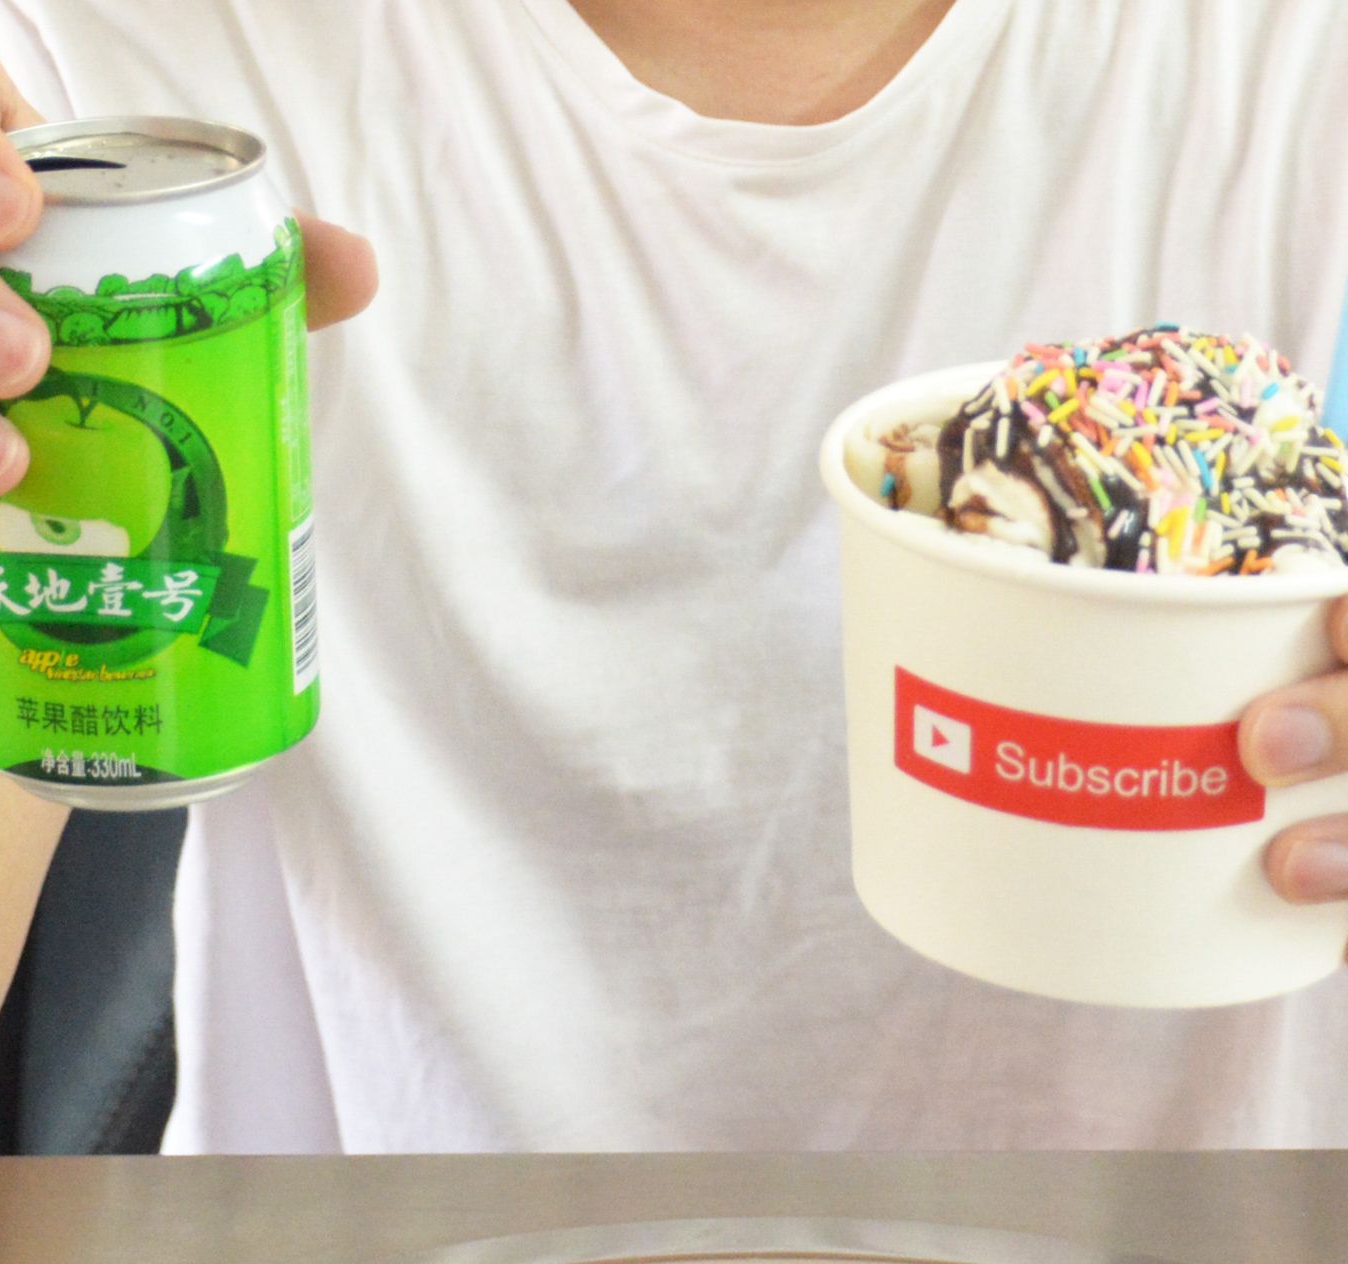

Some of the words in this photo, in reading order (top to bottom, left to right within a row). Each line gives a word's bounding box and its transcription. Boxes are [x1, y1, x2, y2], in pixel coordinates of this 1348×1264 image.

[16, 696, 164, 736] 苹果醋饮料
[994, 740, 1228, 799] Subscribe
